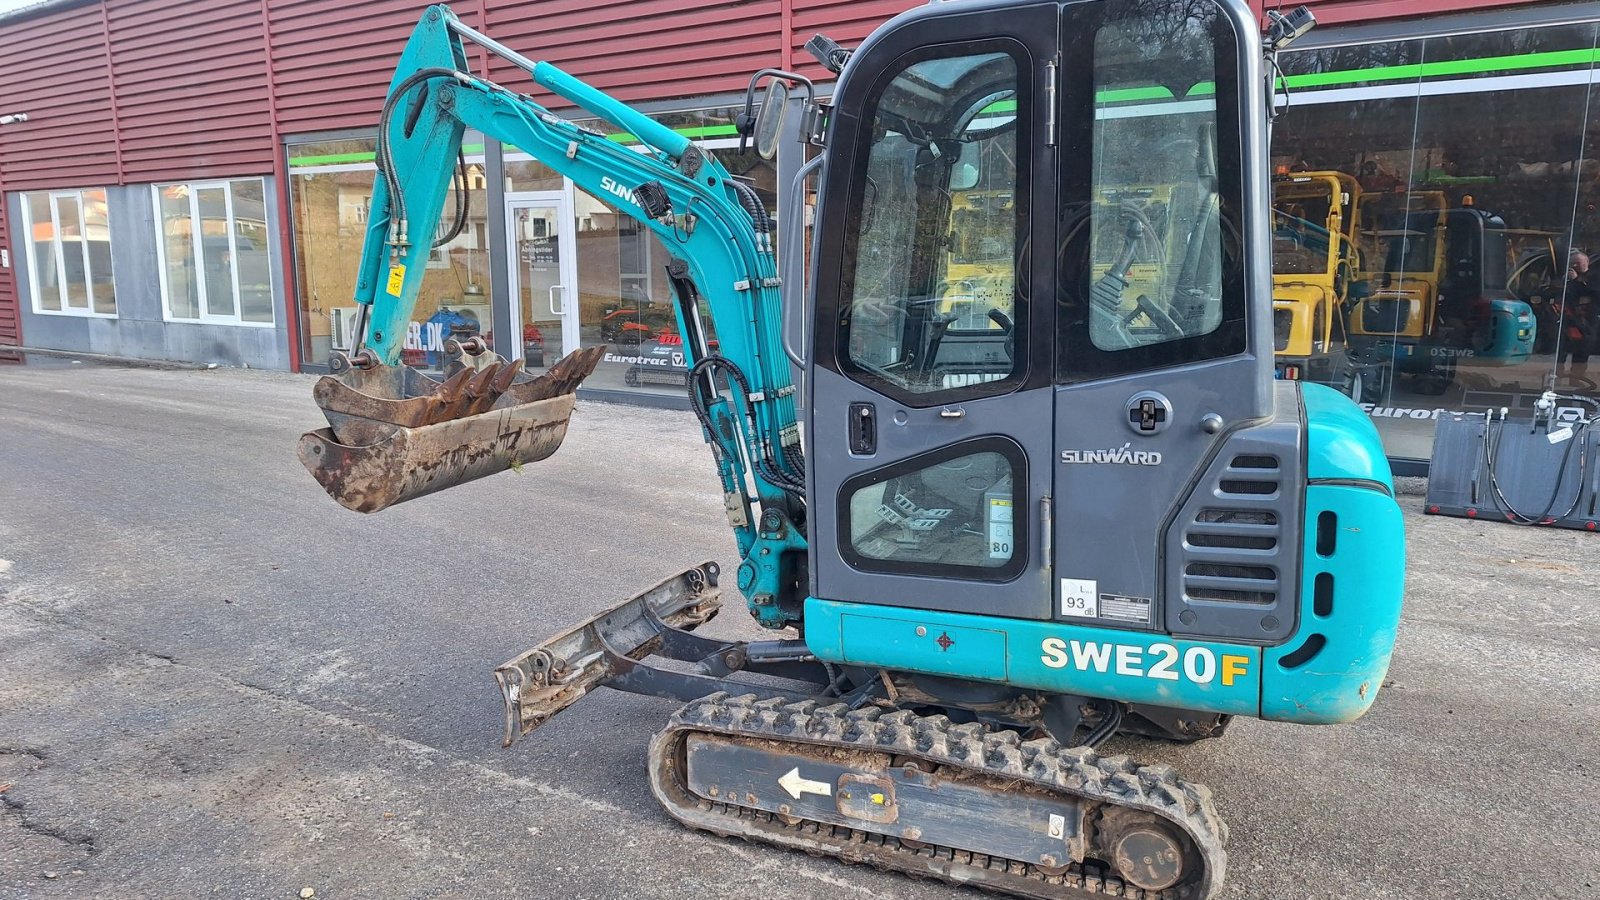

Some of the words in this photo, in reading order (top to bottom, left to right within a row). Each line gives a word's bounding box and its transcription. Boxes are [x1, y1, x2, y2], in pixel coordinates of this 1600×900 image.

[403, 321, 444, 351] ER.DK
[603, 352, 668, 366] Eurotrac
[1061, 442, 1162, 466] SUNWARD
[992, 542, 1009, 553] 80
[1066, 596, 1085, 609] 93
[1084, 607, 1095, 616] dB
[1040, 637, 1249, 686] SWE20F
